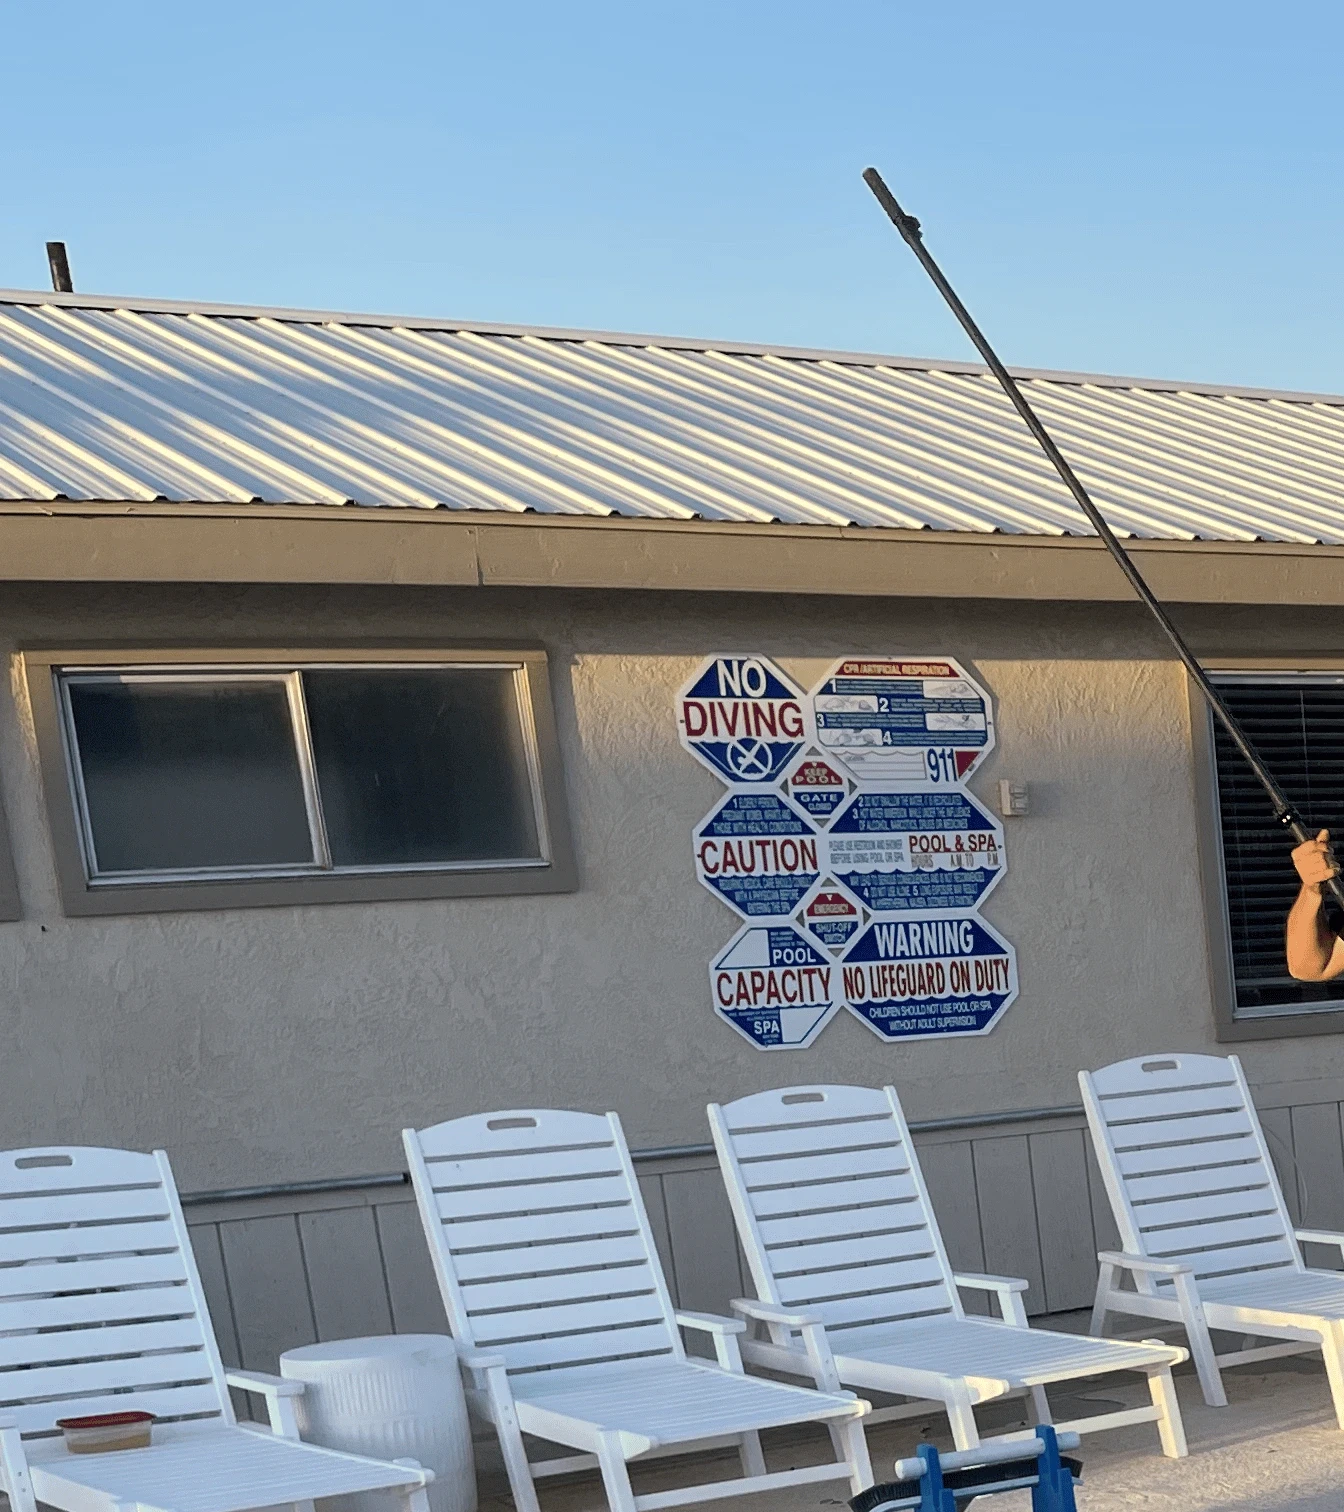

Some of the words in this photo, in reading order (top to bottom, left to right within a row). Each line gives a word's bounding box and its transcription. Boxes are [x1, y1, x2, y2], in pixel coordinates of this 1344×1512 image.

[716, 660, 767, 698] NO
[829, 679, 837, 693] 1
[879, 698, 890, 712] 2
[683, 701, 805, 738] DIVING
[816, 714, 825, 727] 3
[882, 731, 892, 745] 4
[927, 748, 958, 783] 911
[795, 775, 839, 784] POOL
[800, 793, 838, 802] GATE
[909, 835, 951, 853] POOL
[955, 834, 966, 852] &
[968, 834, 998, 852] SPA
[700, 839, 818, 874] CAUTION
[911, 854, 934, 868] HOURS
[815, 922, 852, 934] SHUT-OFF
[873, 920, 974, 958] WARNING
[772, 947, 817, 965] POOL
[717, 967, 831, 1007] CAPACITY
[842, 966, 865, 1000] NO
[869, 961, 946, 998] LIFEGUARD
[950, 960, 971, 993] ON
[974, 958, 1009, 992] DUTY
[869, 1006, 901, 1019] CHILDREN
[900, 1005, 926, 1017] SHOULD
[926, 1003, 939, 1015] NOT
[939, 1003, 953, 1014] USE
[952, 1002, 970, 1013] POOL
[970, 1001, 979, 1012] OR
[980, 1000, 993, 1011] SPA
[754, 1020, 780, 1034] SPA
[888, 1019, 917, 1031] WITHOUT
[917, 1017, 936, 1029] ADULT
[936, 1015, 977, 1029] SUPERVISION
